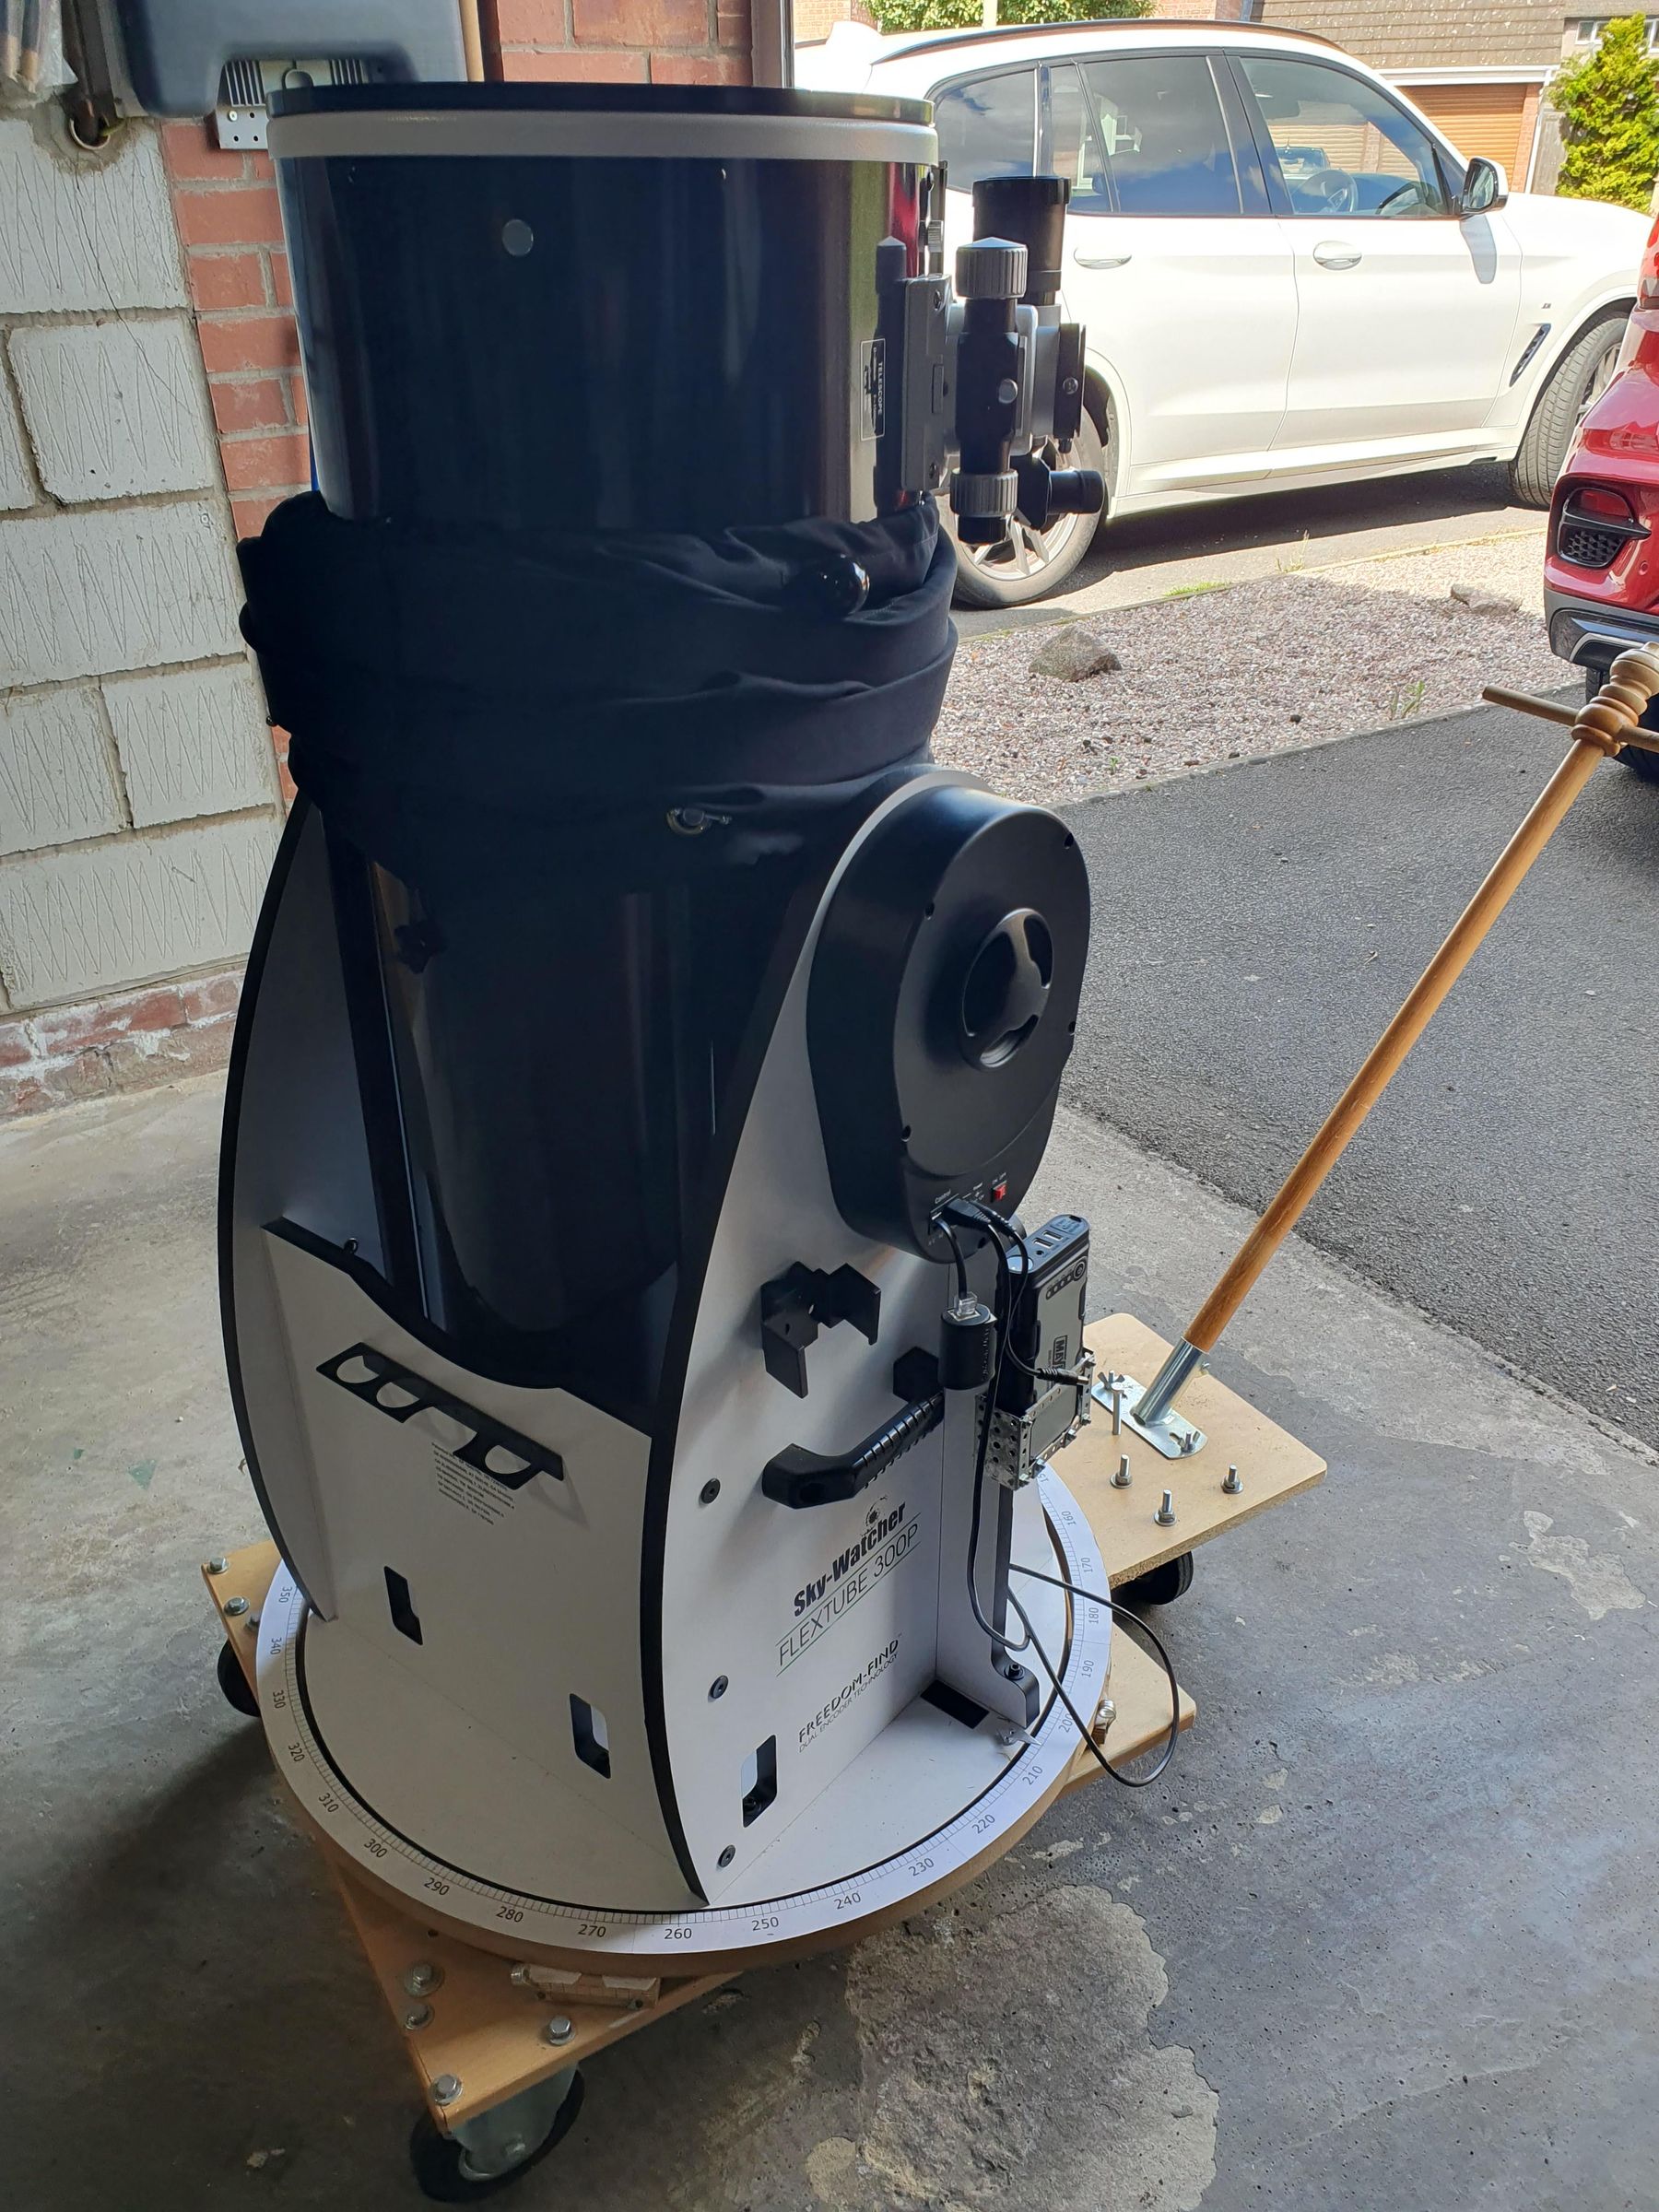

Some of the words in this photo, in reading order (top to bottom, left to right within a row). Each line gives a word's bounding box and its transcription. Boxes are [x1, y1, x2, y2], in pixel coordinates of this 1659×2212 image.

[1061, 1510, 1077, 1527] 160
[794, 1501, 906, 1618] Sky-Watcher
[1083, 1557, 1094, 1573] 170
[278, 1585, 293, 1604] 350
[780, 1567, 869, 1667] FLEXTUBE
[874, 1523, 919, 1578] 300P
[1088, 1606, 1100, 1625] 180
[269, 1637, 283, 1655] 340
[1081, 1659, 1095, 1678] 190
[272, 1688, 287, 1710] 330
[798, 1639, 900, 1744] FREEDOM-FIND
[798, 1732, 818, 1754] DUAL
[819, 1697, 853, 1734] ENCODER
[853, 1651, 900, 1700] TECHNOLOGY
[287, 1742, 306, 1763] 320
[1021, 1764, 1044, 1786] 210
[317, 1792, 340, 1814] 310
[971, 1813, 996, 1835] 220
[363, 1838, 389, 1859] 300
[907, 1856, 935, 1877] 230
[423, 1877, 451, 1897] 290
[833, 1891, 862, 1911] 240
[495, 1905, 524, 1924] 280
[751, 1915, 780, 1933] 250
[577, 1923, 607, 1938] 270
[663, 1927, 693, 1940] 260
